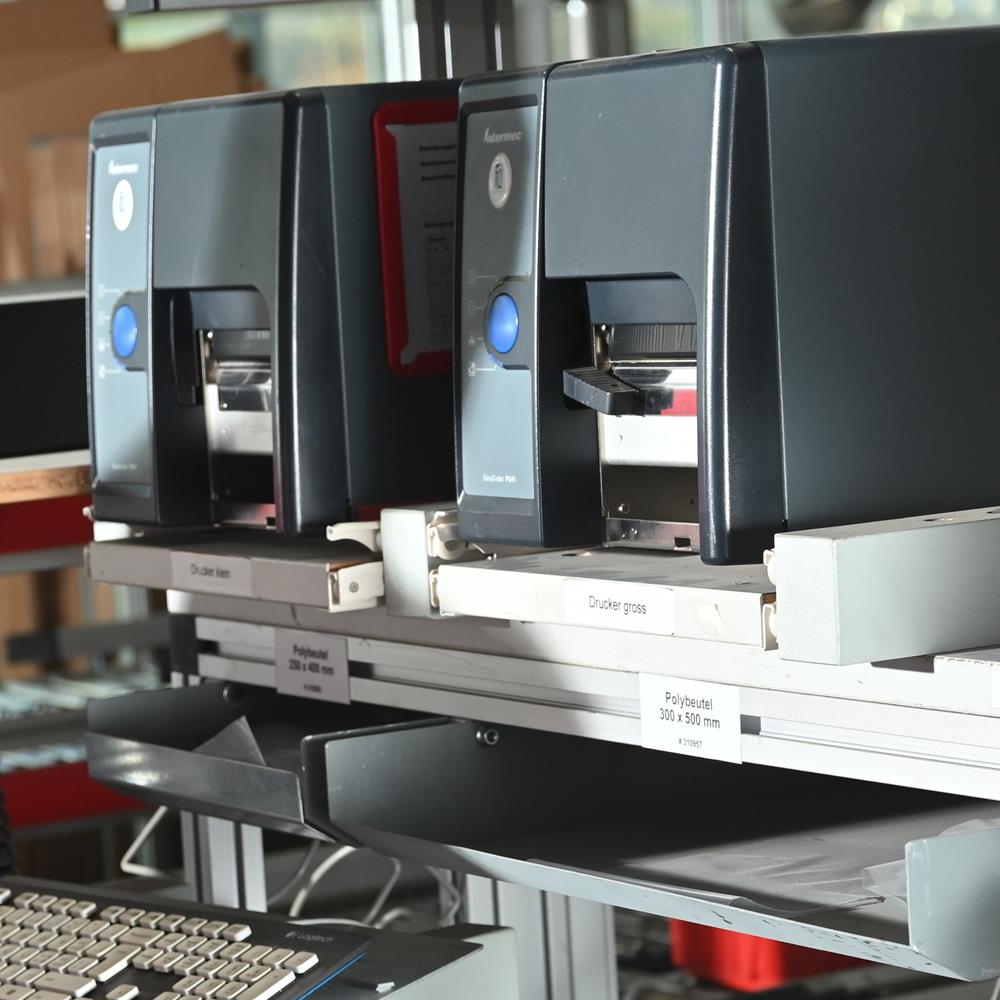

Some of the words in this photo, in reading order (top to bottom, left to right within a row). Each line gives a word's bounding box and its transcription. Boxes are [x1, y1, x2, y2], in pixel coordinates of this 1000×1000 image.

[483, 127, 522, 143] Intermec
[588, 595, 621, 611] Drucker
[623, 602, 647, 616] gross
[665, 691, 713, 711] Polybeutel
[659, 707, 675, 722] 300
[677, 713, 684, 723] x
[685, 711, 701, 726] 500
[703, 717, 721, 729] mm
